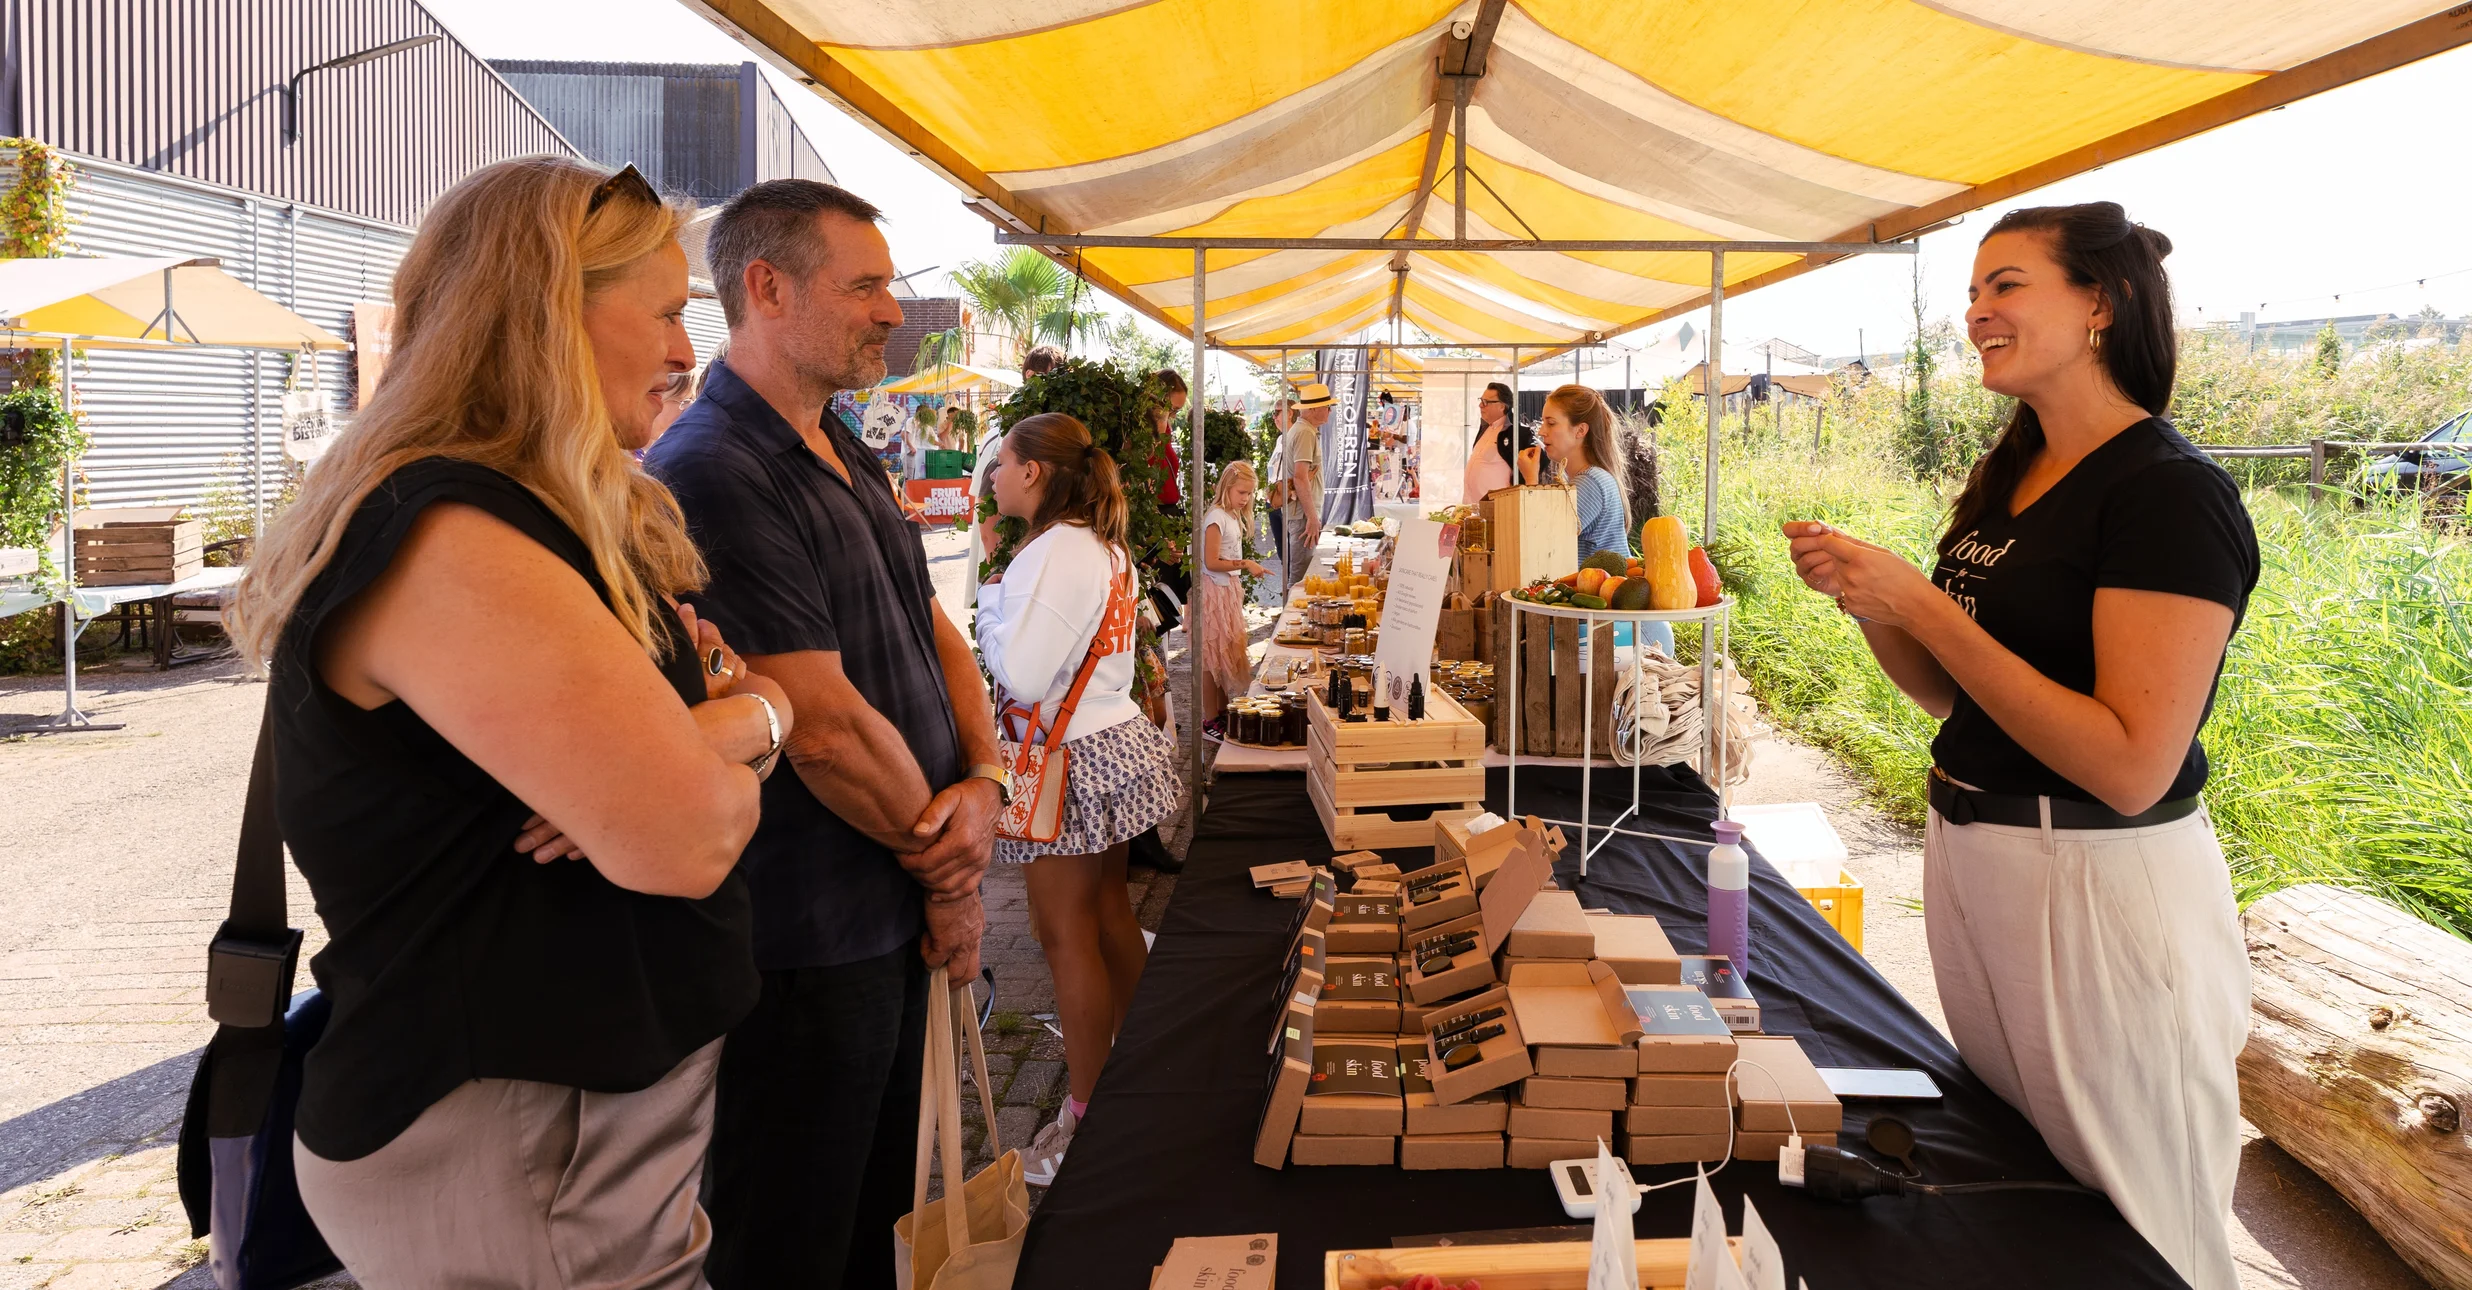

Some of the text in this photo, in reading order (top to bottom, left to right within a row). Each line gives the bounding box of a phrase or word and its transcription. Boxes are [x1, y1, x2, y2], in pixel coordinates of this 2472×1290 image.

[931, 487, 962, 497] FRUIT
[924, 496, 969, 506] PACKING
[924, 506, 970, 515] DISTRICT
[1946, 529, 2016, 567] food
[1943, 578, 1977, 621] kin
[1358, 904, 1370, 915] skin
[1377, 904, 1391, 915] food
[1352, 973, 1367, 987] skin
[1374, 972, 1389, 987] food
[1663, 1004, 1681, 1020] skin
[1687, 1004, 1712, 1021] food
[1345, 1059, 1363, 1076] skin
[1370, 1060, 1389, 1079] food
[1193, 1266, 1217, 1288] skin
